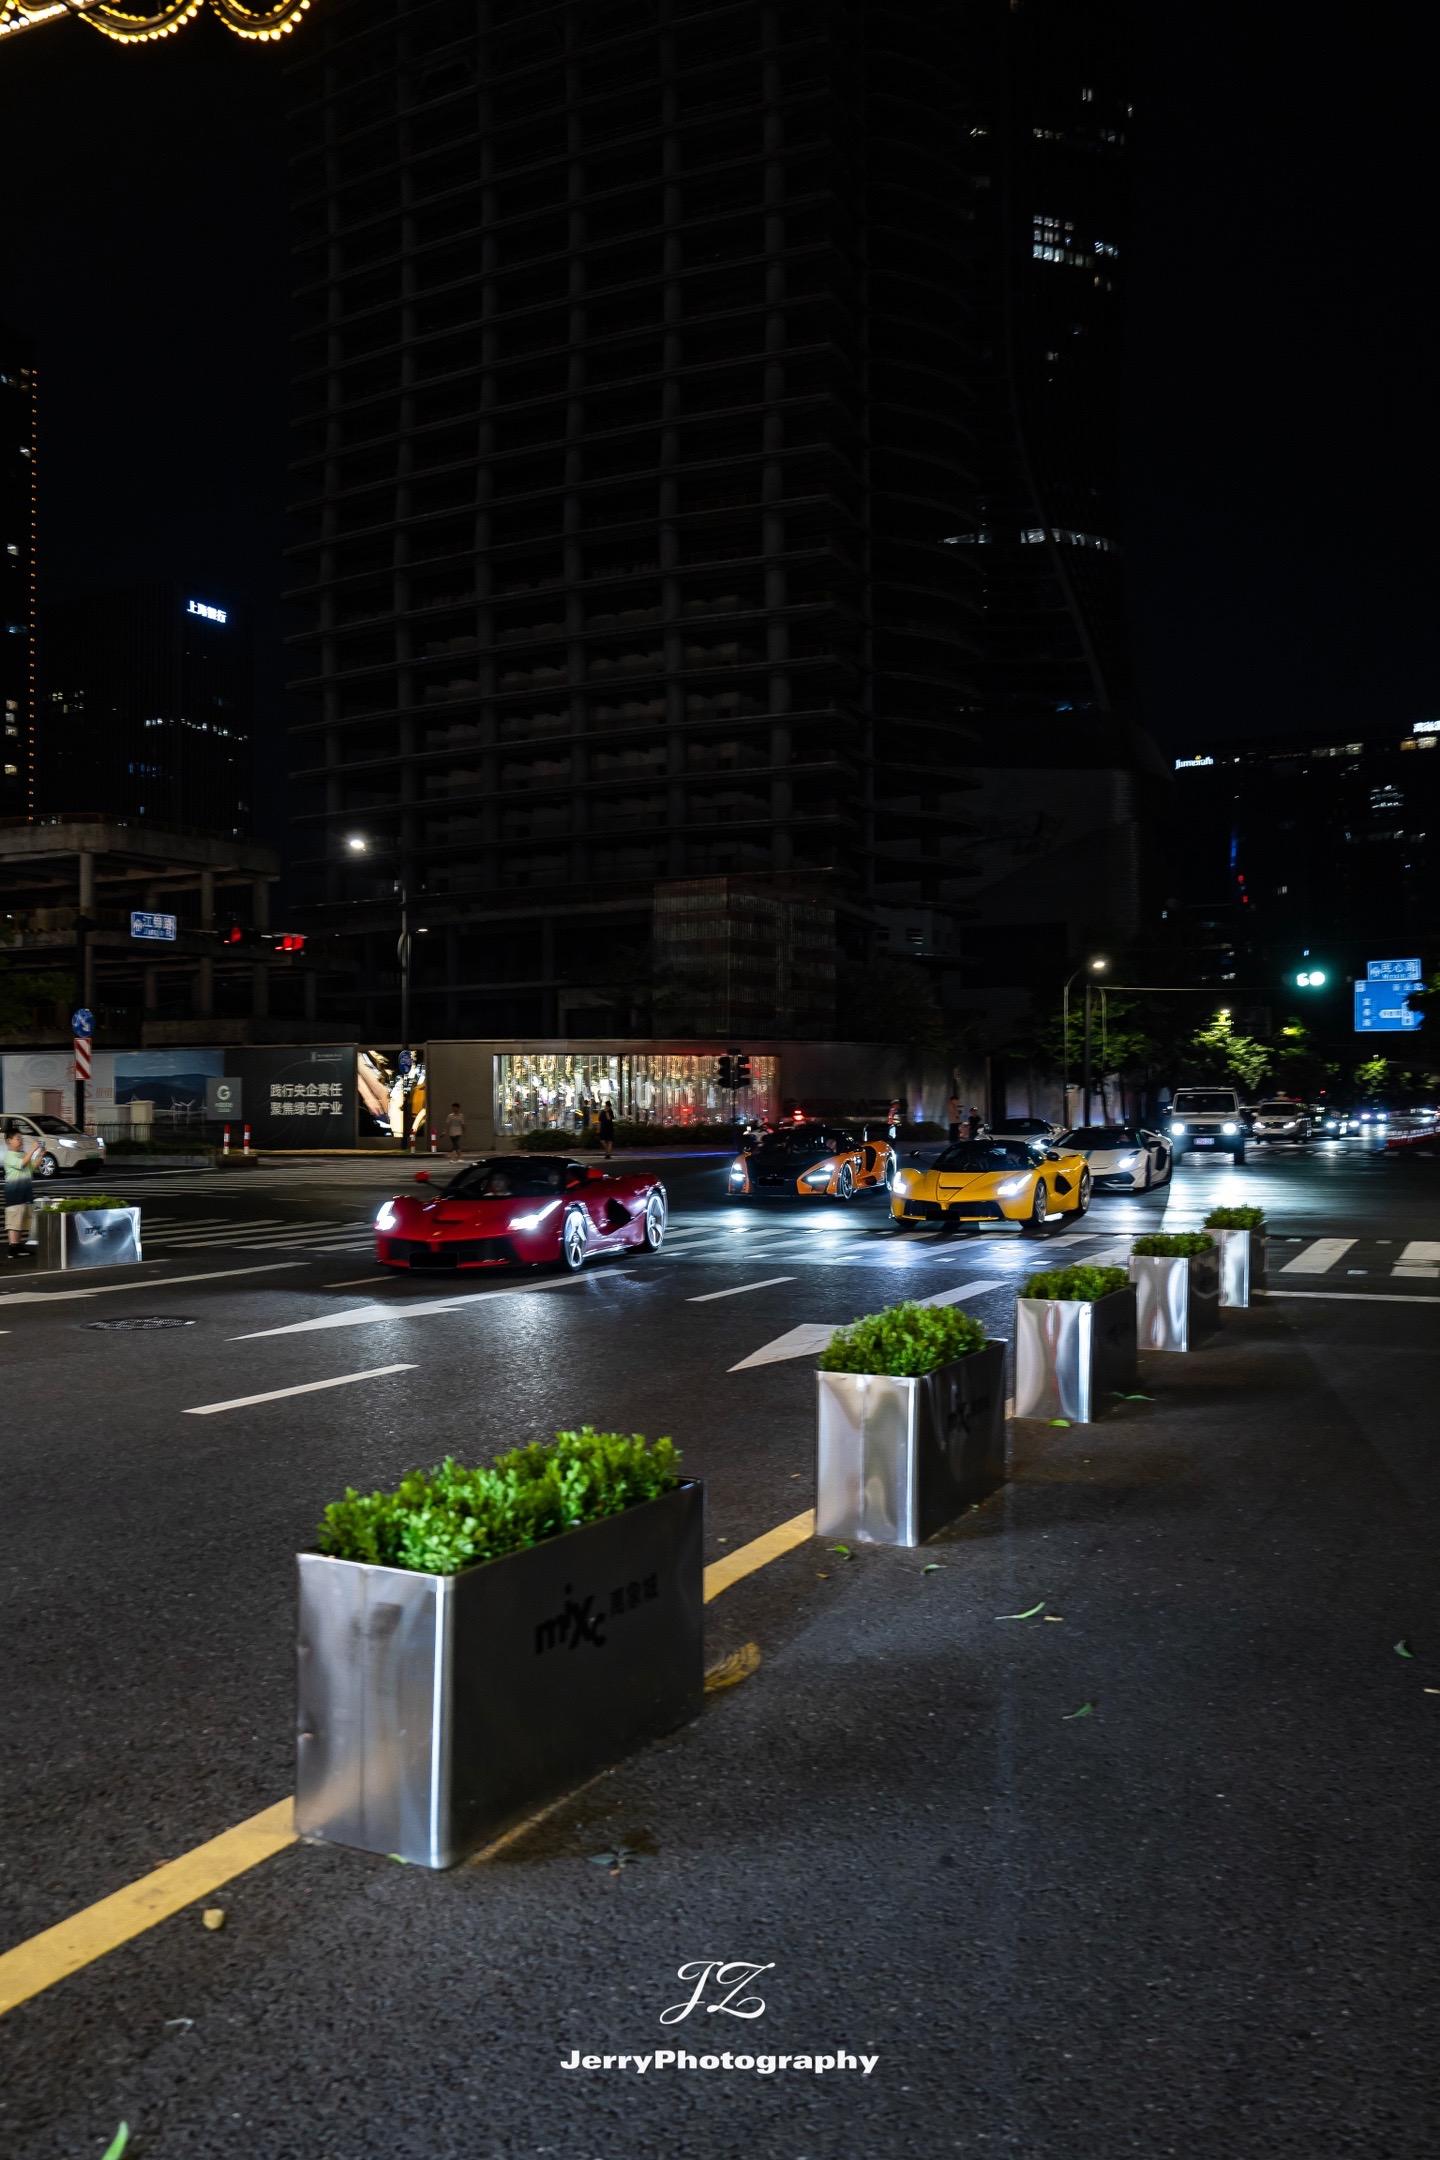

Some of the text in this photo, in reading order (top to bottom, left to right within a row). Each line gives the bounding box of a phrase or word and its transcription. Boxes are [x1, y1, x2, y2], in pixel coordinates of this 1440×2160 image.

[270, 1083, 343, 1097] 践行央企责任
[270, 1101, 343, 1116] 聚焦绿色产业
